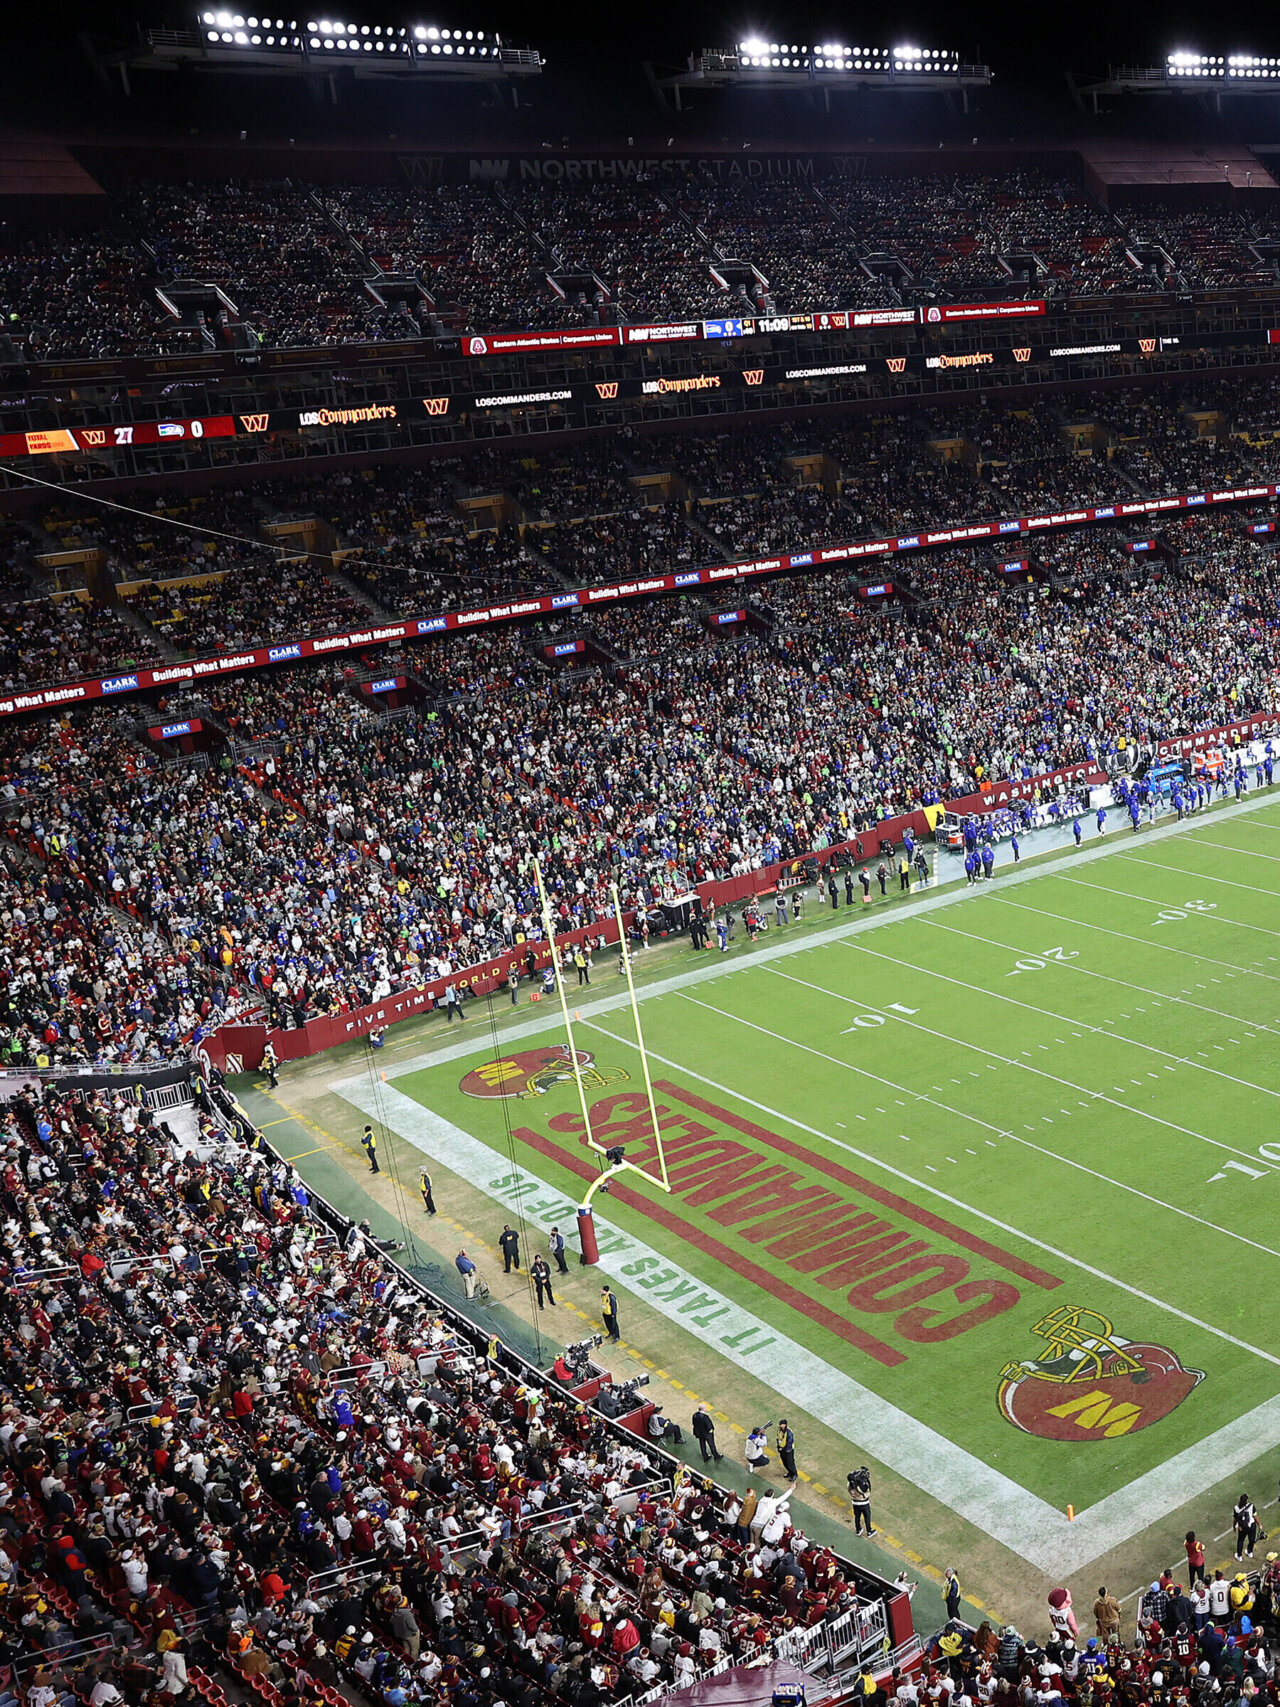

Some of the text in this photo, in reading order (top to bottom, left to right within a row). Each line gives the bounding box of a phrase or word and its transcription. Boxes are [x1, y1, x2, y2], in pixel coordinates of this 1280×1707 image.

[519, 159, 690, 180] NORTHWEST
[697, 159, 815, 179] STADIUM
[872, 311, 915, 320] NORTHWEST
[628, 328, 649, 341] NW
[649, 325, 697, 336] NORTHWEST
[758, 318, 789, 332] 11:09
[493, 340, 517, 348] Eastern
[517, 339, 540, 347] Atlantic
[562, 335, 596, 343] Carpenters
[1050, 344, 1121, 357] LOSCOMMANDERS.COM
[785, 365, 867, 379] LOSCOMMANDERS.COM
[475, 391, 572, 407] LOSCOMMANDERS.COM
[113, 427, 134, 445] 27
[190, 421, 203, 438] 0
[27, 434, 48, 442] TOTAL
[29, 442, 52, 450] YARDS
[1027, 513, 1088, 527] Building What Matters
[1095, 508, 1115, 516] CLARK
[675, 573, 700, 583] CLARK
[588, 580, 665, 600] Building What Matters
[551, 595, 578, 605] CLARK
[457, 602, 541, 624] Building What Matters
[718, 612, 738, 620] CLARK
[417, 618, 446, 630] CLARK
[313, 627, 406, 651] Building What Matters
[268, 646, 300, 658] CLARK
[554, 643, 577, 652] CLARK
[153, 655, 255, 682] Building What Matters
[101, 676, 138, 690] CLARK
[372, 679, 395, 689] CLARK
[14, 694, 43, 708] What
[44, 687, 86, 703] Matters
[162, 723, 190, 734] CLARK
[982, 764, 1098, 806] WASHINGTON
[1157, 899, 1218, 920] 30
[1014, 946, 1080, 971] 20
[345, 941, 572, 1033] FIVE TIME ORLD CMPS
[853, 1001, 921, 1028] 10
[488, 1173, 541, 1201] US
[524, 1199, 578, 1223] OF
[548, 1091, 1022, 1343] COMMANDERS
[619, 1256, 732, 1329] TAKES
[719, 1326, 779, 1358] IT
